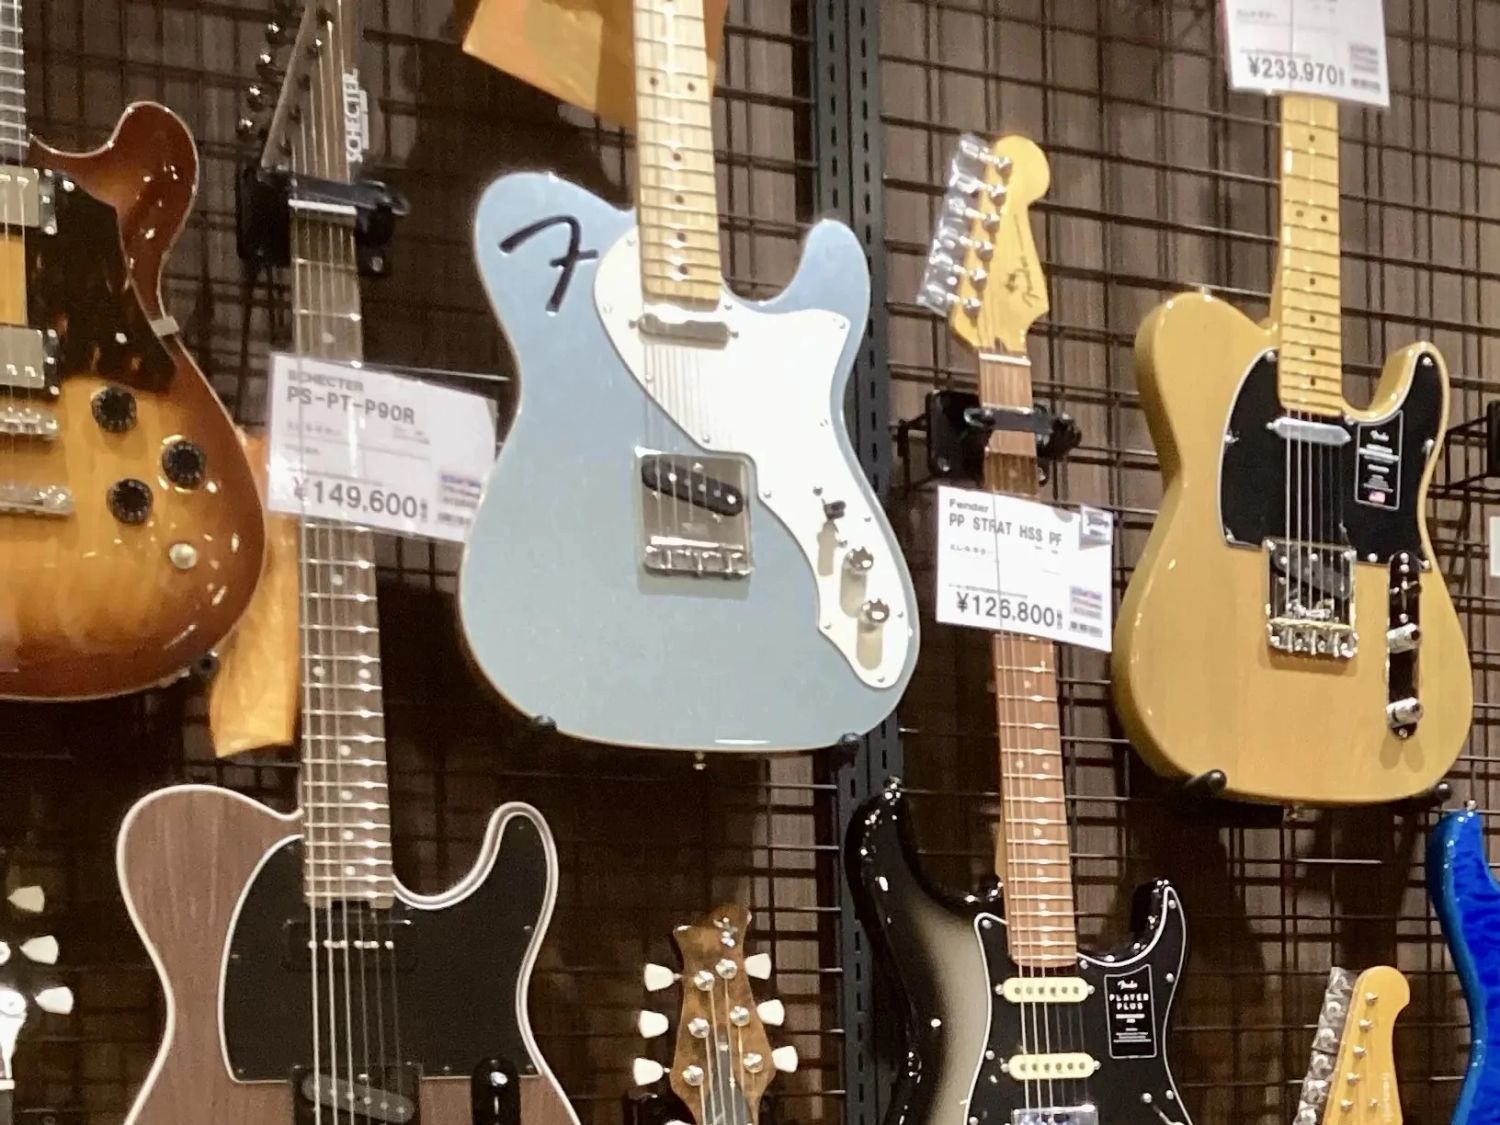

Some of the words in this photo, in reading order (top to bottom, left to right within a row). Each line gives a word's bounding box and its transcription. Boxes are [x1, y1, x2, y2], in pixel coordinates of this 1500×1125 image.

[286, 385, 416, 425] PS-PT-P90R
[948, 512, 966, 528] PP
[972, 516, 1012, 536] STRAT
[1019, 524, 1043, 543] HSS
[1116, 1002, 1143, 1011] PLUS
